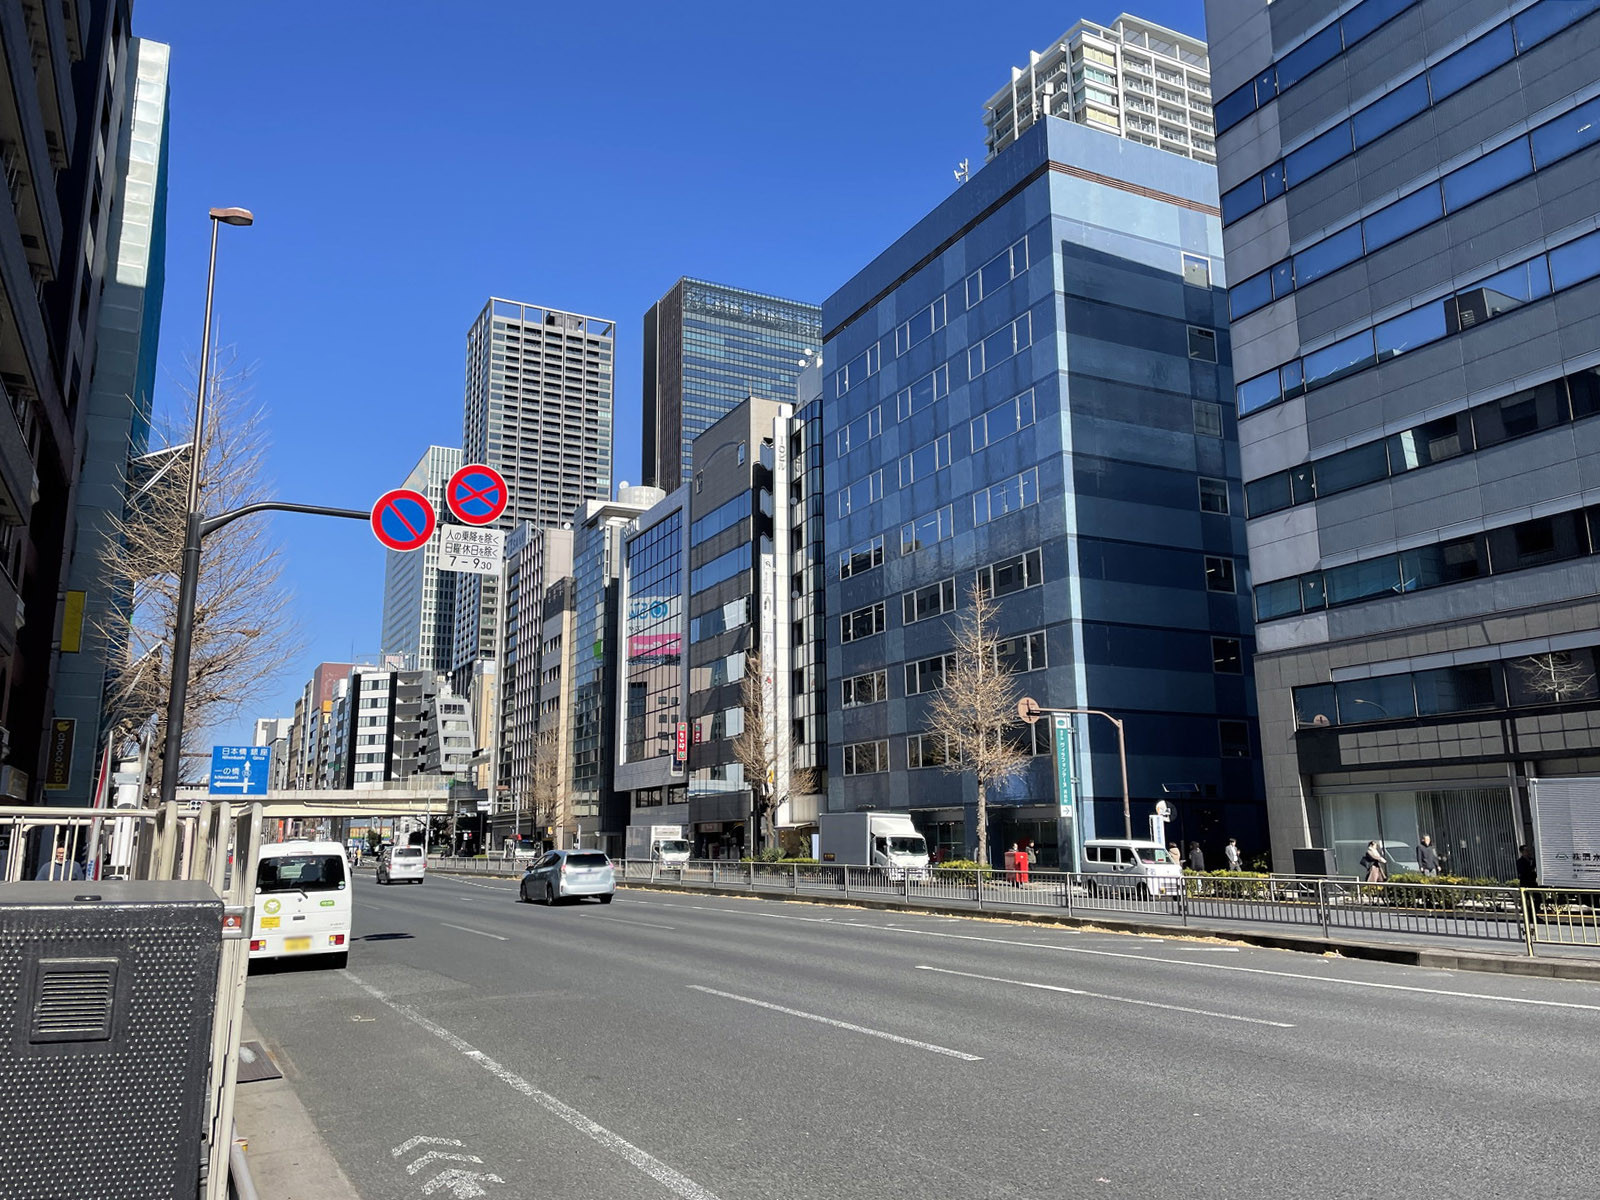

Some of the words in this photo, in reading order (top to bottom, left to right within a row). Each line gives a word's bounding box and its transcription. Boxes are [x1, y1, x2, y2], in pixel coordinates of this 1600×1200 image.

[446, 529, 500, 544] 人の乗降を除く
[222, 747, 247, 756] 日本橋
[214, 767, 240, 775] 一の橋
